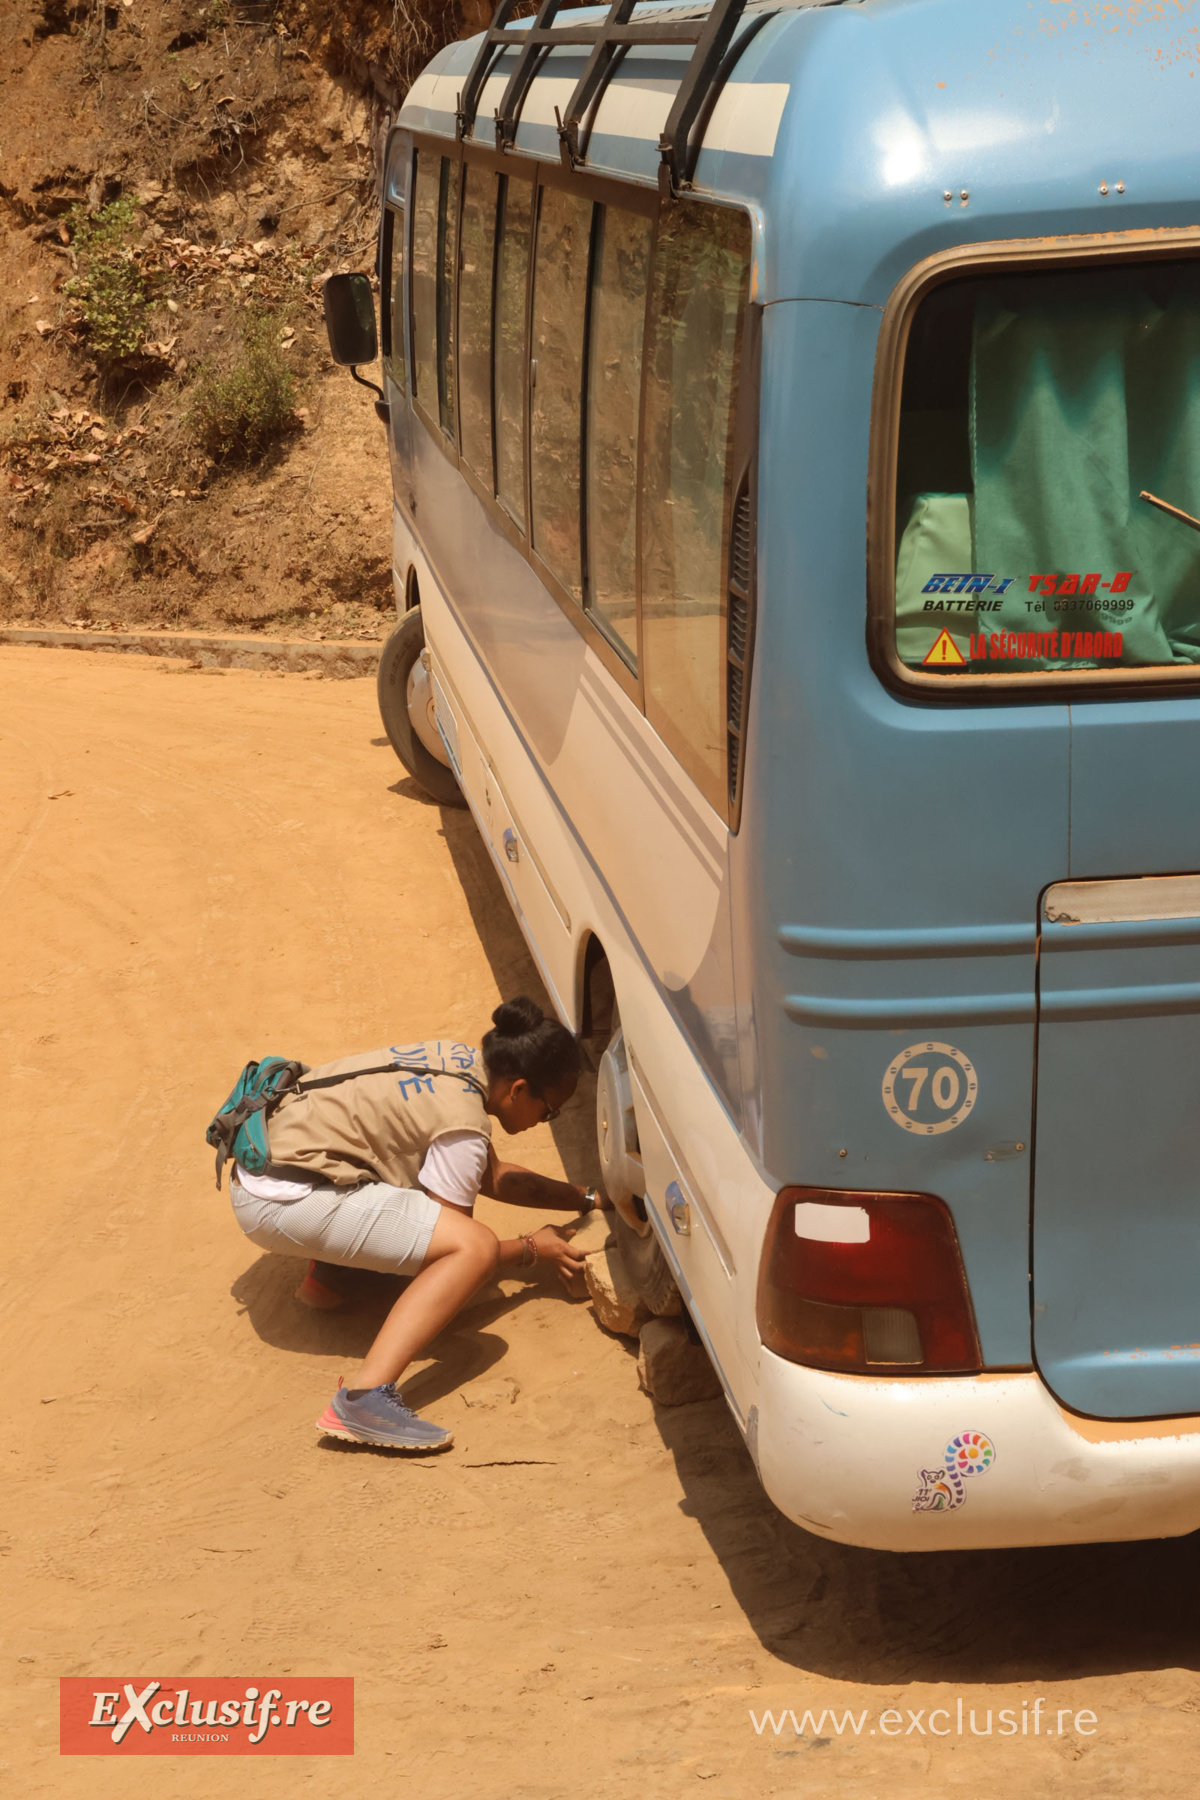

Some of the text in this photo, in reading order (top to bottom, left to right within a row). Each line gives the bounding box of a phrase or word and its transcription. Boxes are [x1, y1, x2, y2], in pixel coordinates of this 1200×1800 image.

[1028, 572, 1133, 595] TSAR-B
[923, 600, 1003, 611] BATTERIE
[1024, 599, 1134, 613] Tél 0337069999
[969, 627, 1123, 660] LA SÉCURITÉ D'ABORD
[901, 1066, 960, 1111] 70
